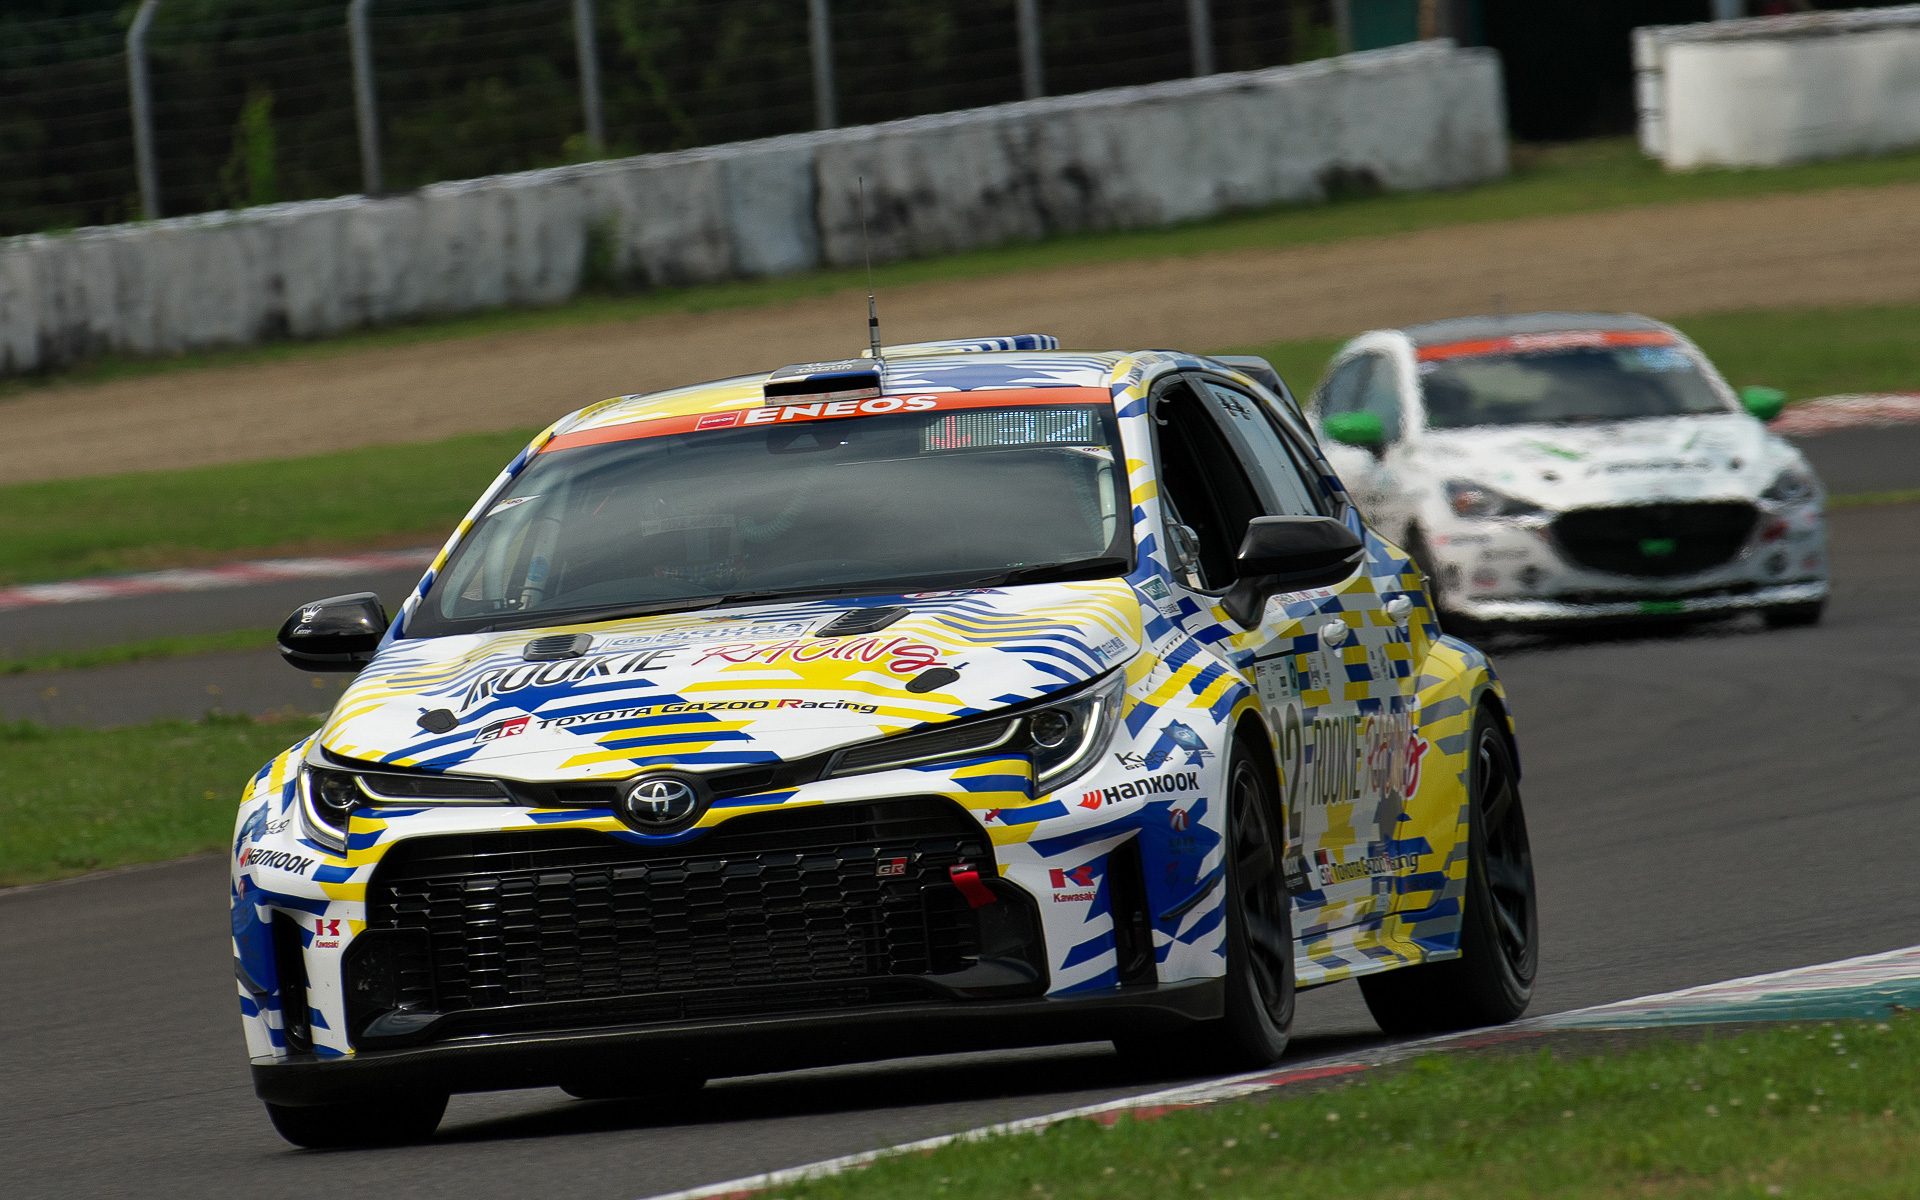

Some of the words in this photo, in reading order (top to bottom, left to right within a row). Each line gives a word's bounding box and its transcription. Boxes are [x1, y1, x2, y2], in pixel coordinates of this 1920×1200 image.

[743, 395, 938, 425] ENEOS
[701, 416, 735, 425] ENEOS
[460, 648, 690, 712] ROOKIE
[537, 707, 652, 729] TOYOTA
[661, 700, 770, 713] GAZOO
[777, 699, 879, 714] Racing
[877, 862, 906, 876] GR
[1053, 890, 1096, 903] Kawasaki
[316, 939, 339, 948] Kawasaki
